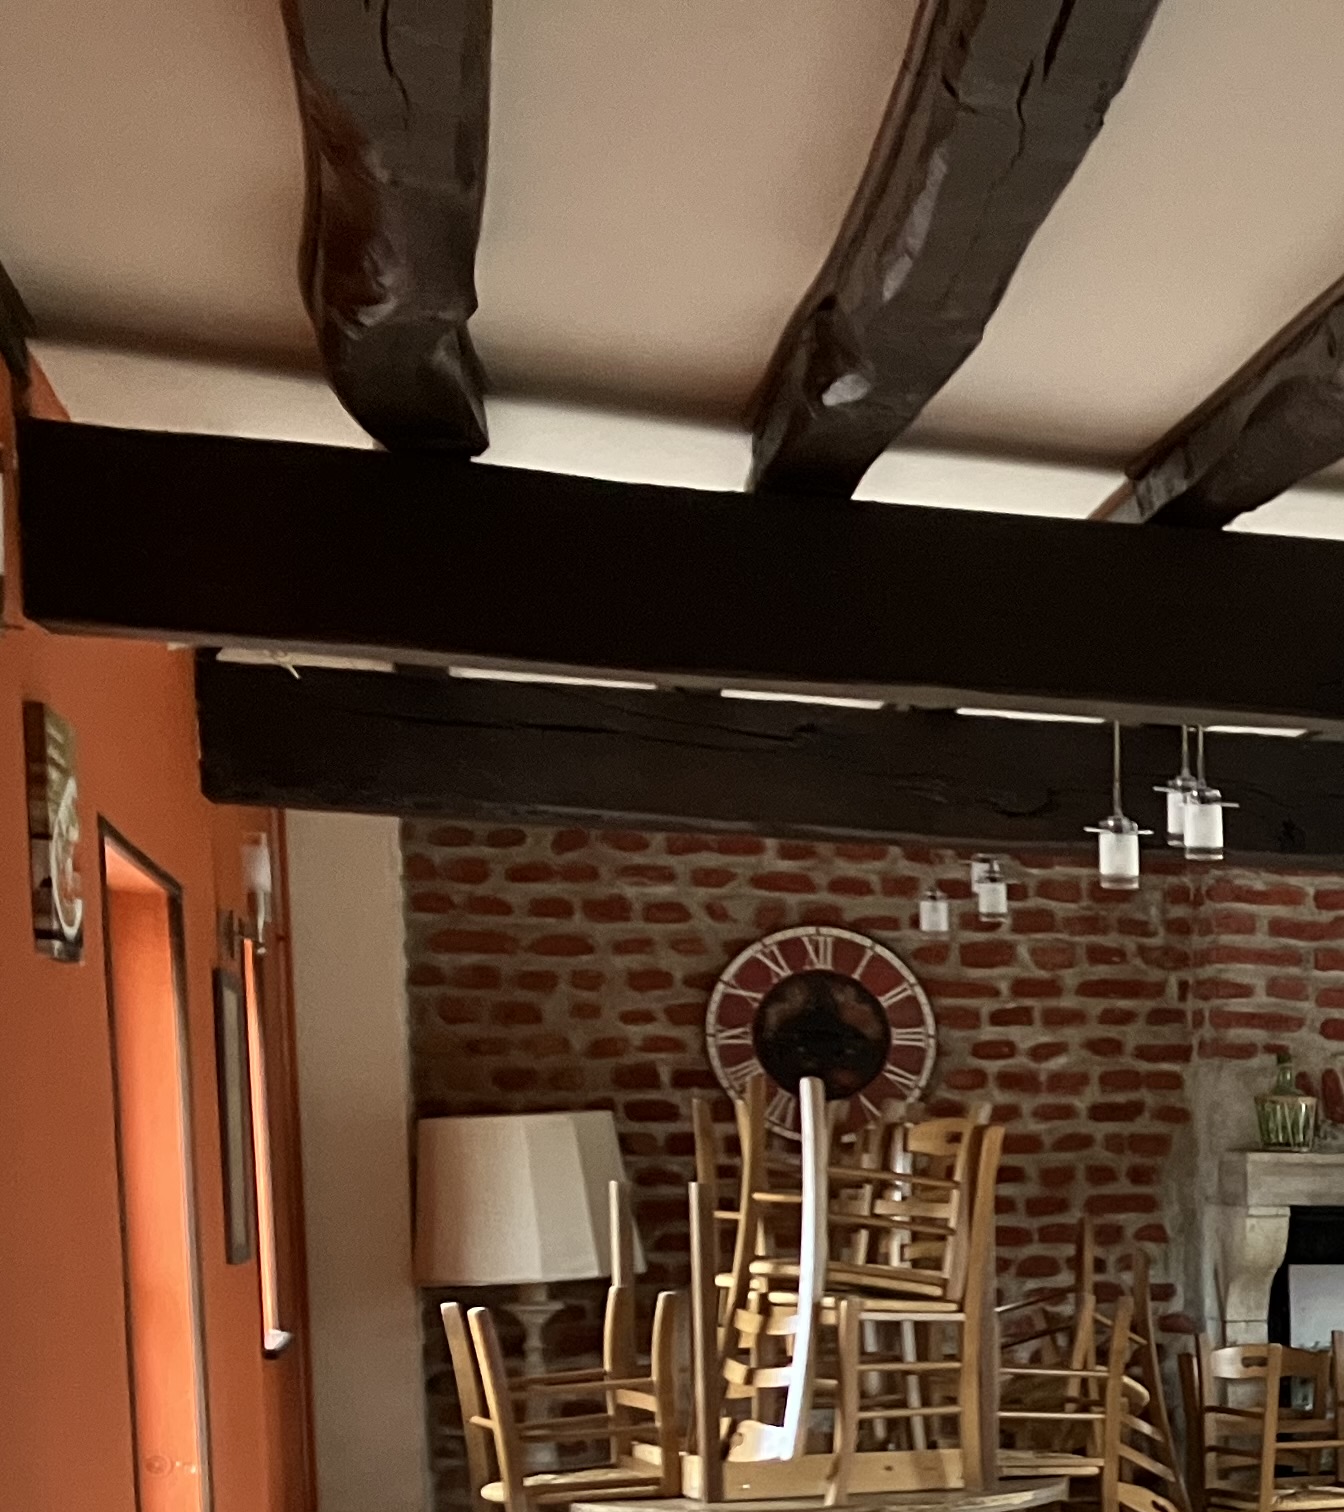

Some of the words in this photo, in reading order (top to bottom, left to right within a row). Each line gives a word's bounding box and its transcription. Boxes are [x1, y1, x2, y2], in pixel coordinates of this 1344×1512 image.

[752, 942, 794, 984] XI
[800, 935, 834, 970] XII
[851, 947, 874, 980] I
[877, 981, 916, 1008] II
[891, 1026, 928, 1049] III
